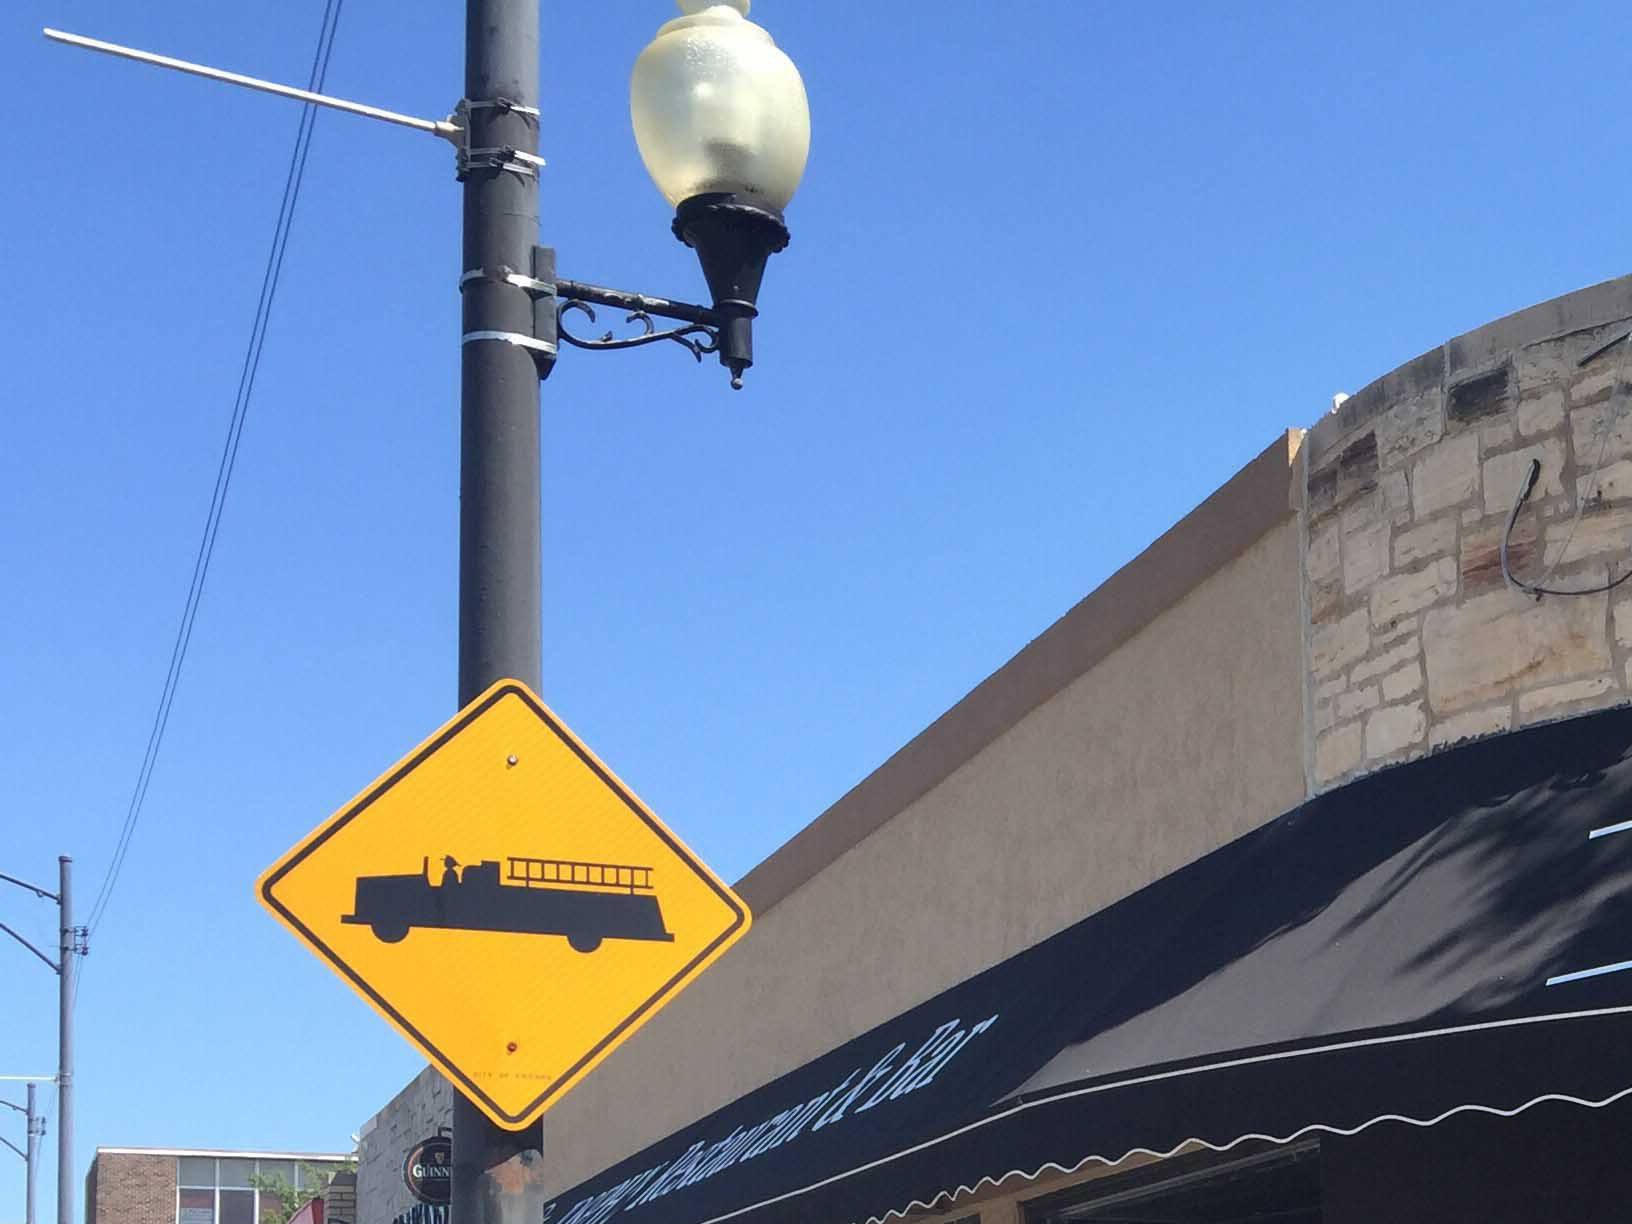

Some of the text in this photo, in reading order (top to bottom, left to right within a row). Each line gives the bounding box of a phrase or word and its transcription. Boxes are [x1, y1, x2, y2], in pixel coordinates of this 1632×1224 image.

[811, 1042, 906, 1132] &
[853, 1014, 999, 1114] Bar
[624, 1068, 862, 1212] Restaurant
